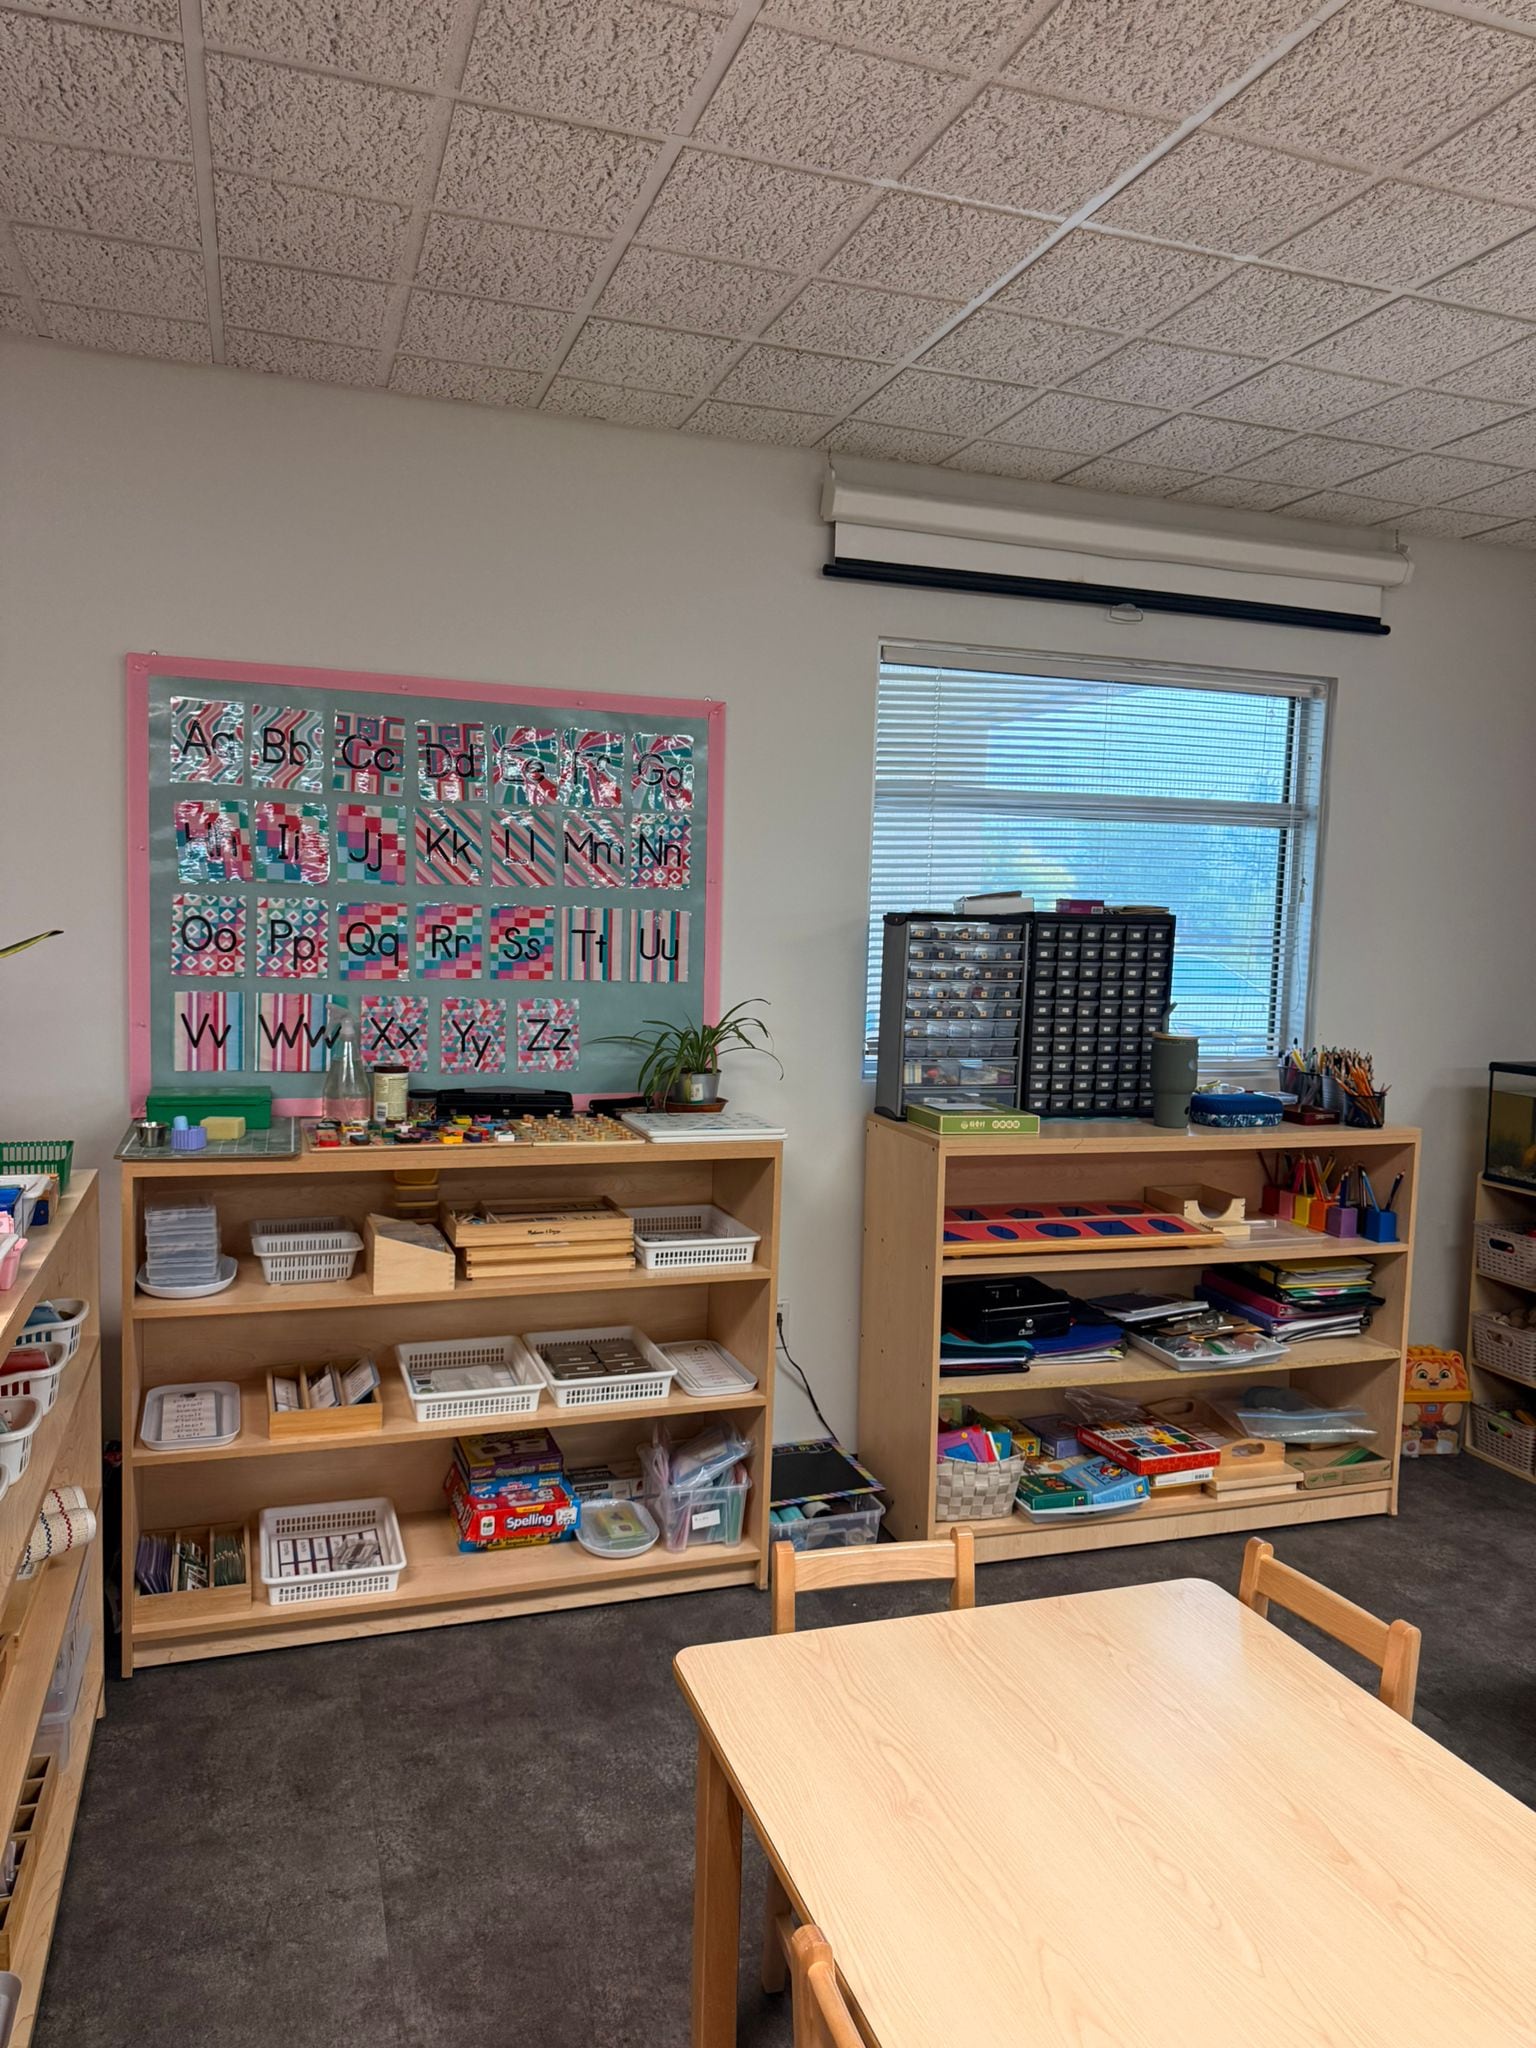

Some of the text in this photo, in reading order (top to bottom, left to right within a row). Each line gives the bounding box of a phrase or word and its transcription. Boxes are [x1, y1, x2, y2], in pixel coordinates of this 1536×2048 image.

[182, 720, 234, 757] Aa
[262, 727, 312, 765] Bb
[341, 734, 395, 772] Cc
[426, 743, 476, 778] Dd
[501, 746, 546, 784] Ee
[638, 753, 686, 799] Gg
[278, 823, 300, 860] Ii
[349, 828, 383, 873] Jj
[426, 827, 473, 865] Kk
[503, 829, 535, 866] Ll
[564, 831, 624, 865] Mm
[639, 833, 682, 867] Nn
[181, 915, 679, 970] Oo Pp Qq Rr Ss Tt Uu
[181, 1013, 572, 1068] Vv Ww Xx Yy Zz
[506, 1513, 553, 1530] Spelling
